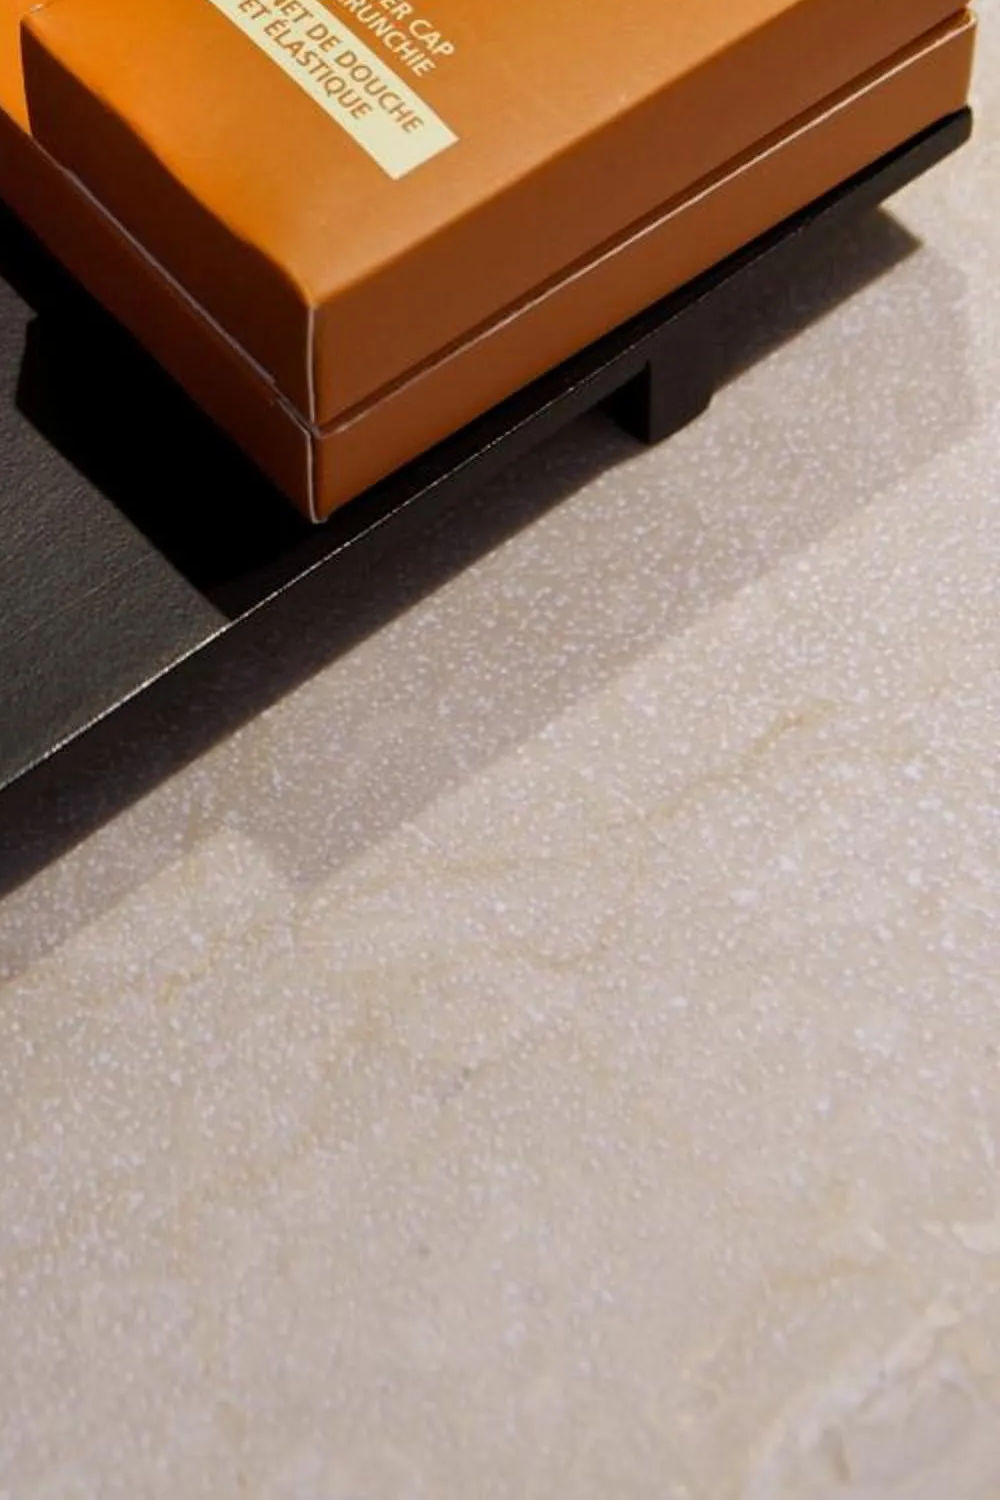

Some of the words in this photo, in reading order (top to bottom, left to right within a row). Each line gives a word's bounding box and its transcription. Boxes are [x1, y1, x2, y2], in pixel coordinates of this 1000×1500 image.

[263, 17, 374, 120] ÉLASTIQUE
[306, 23, 341, 53] DE
[335, 50, 425, 134] DOUCHE
[408, 18, 455, 56] CAP
